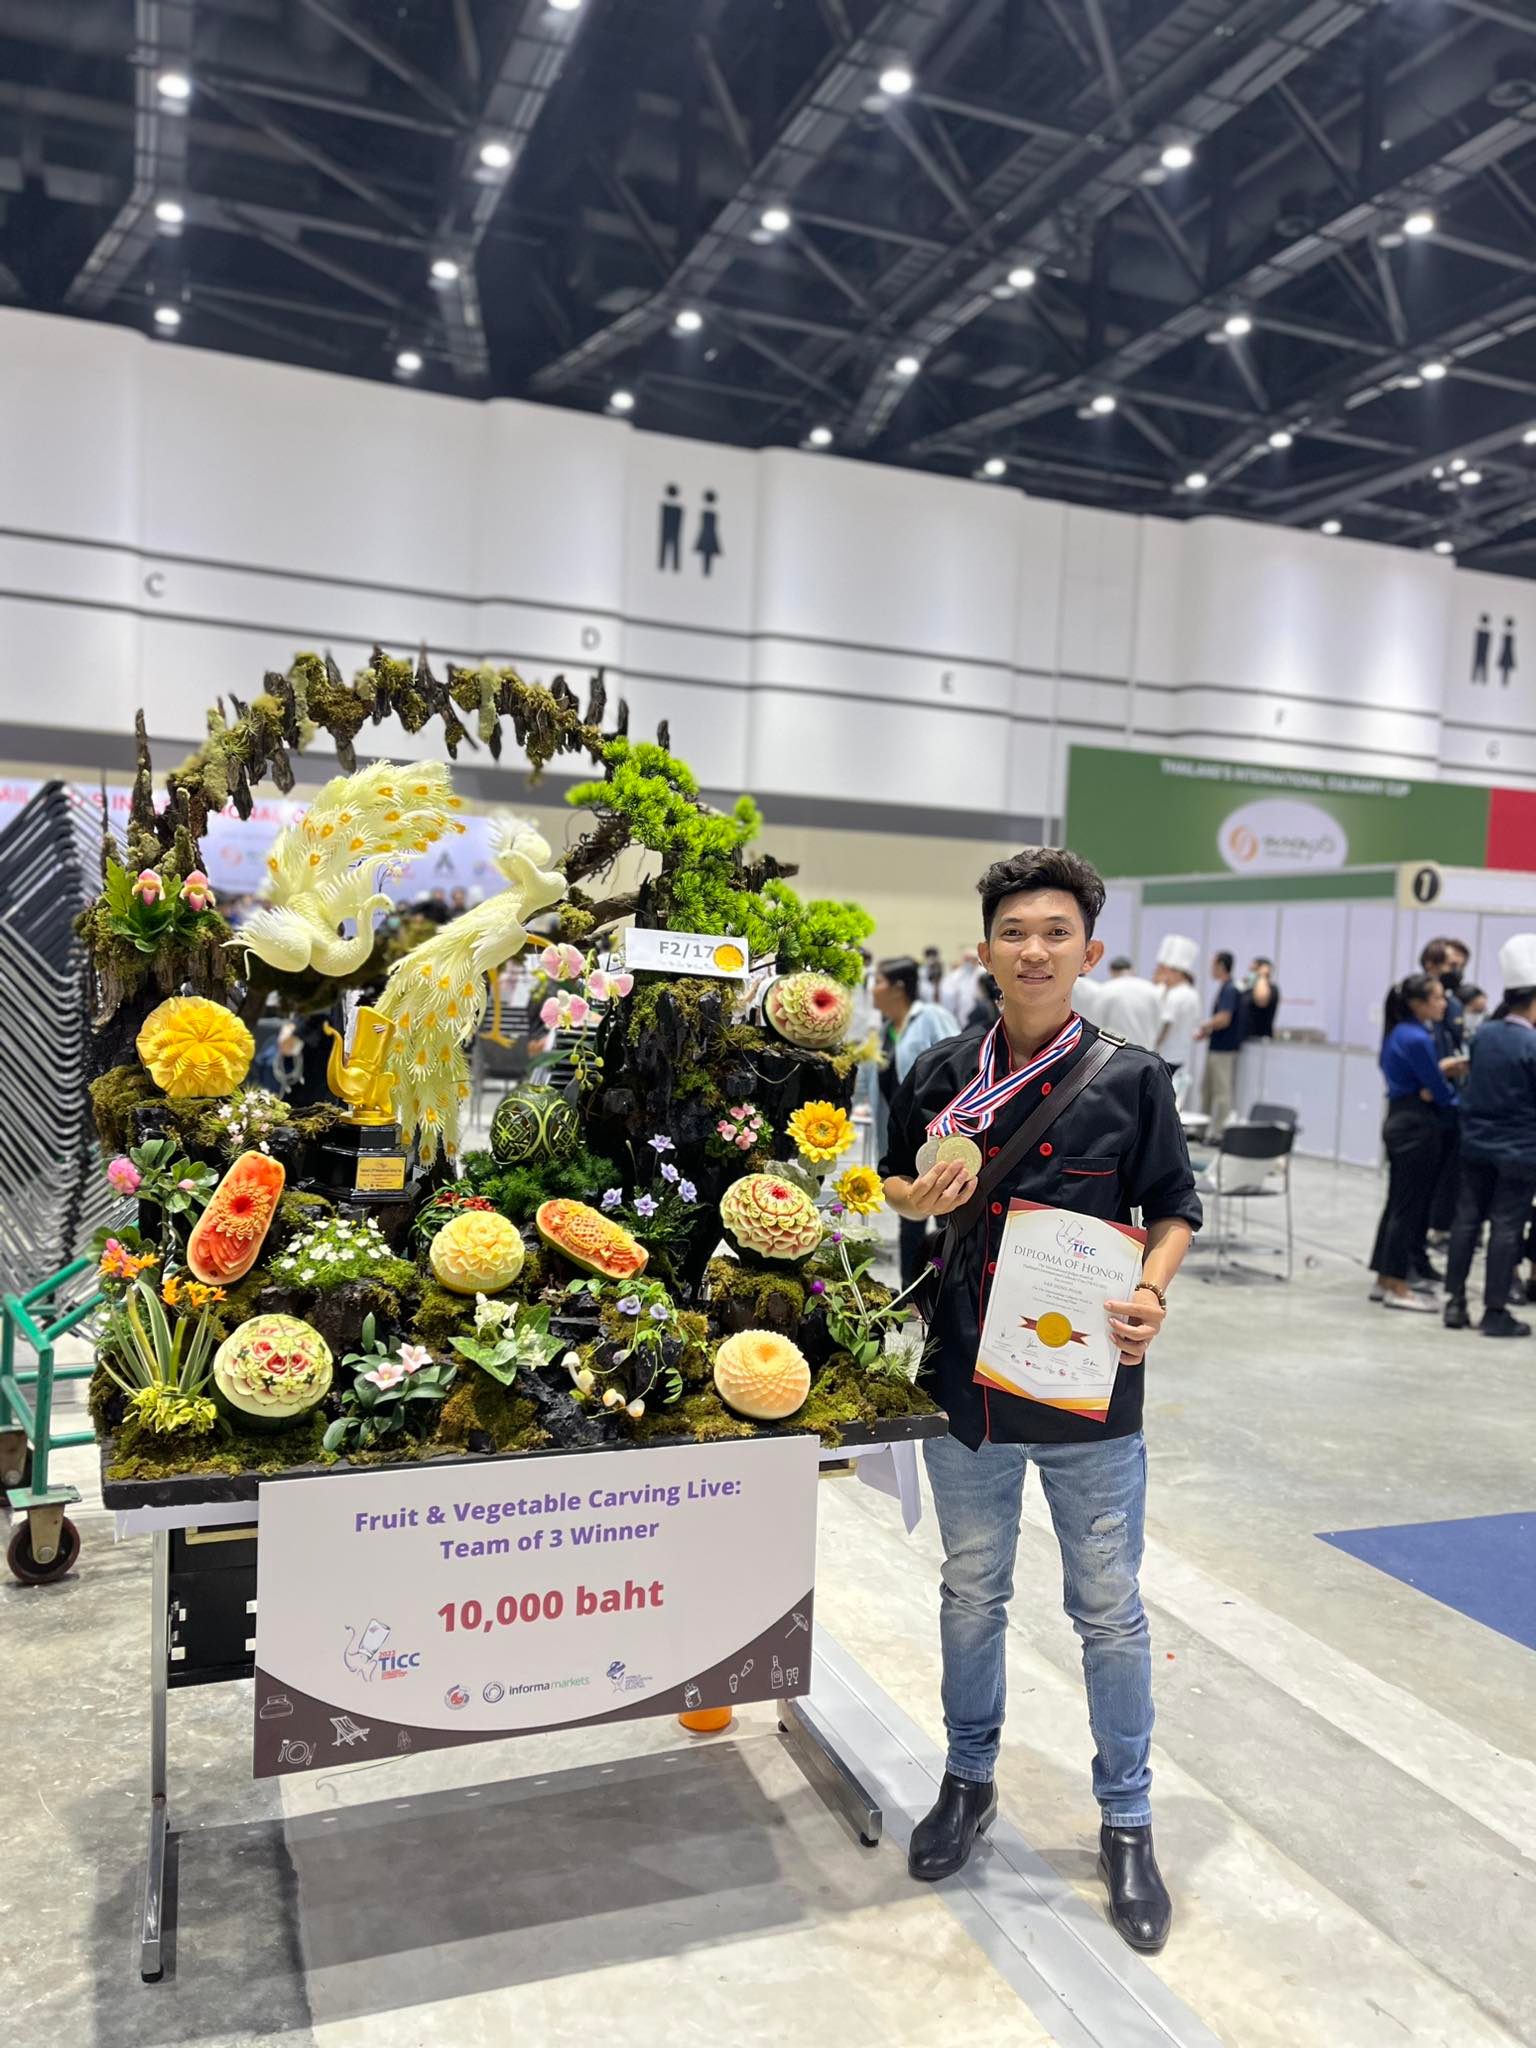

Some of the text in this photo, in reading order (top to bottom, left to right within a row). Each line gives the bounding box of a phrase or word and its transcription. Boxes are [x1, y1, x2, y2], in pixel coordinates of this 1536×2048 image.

[144, 572, 165, 598] C
[582, 627, 601, 651] D
[941, 670, 954, 694] E
[1421, 871, 1431, 900] 1
[659, 941, 715, 958] F2/17
[1073, 1243, 1096, 1256] TICC
[1013, 1245, 1062, 1266] DIPLOMA
[1064, 1258, 1081, 1270] OF
[1081, 1262, 1124, 1282] HONOR
[355, 1477, 742, 1532] Fruit & Vegetable Carving Live:
[440, 1519, 660, 1560] Team of 3 Winner
[437, 1579, 664, 1634] 10,000 baht
[378, 1652, 421, 1671] TICC
